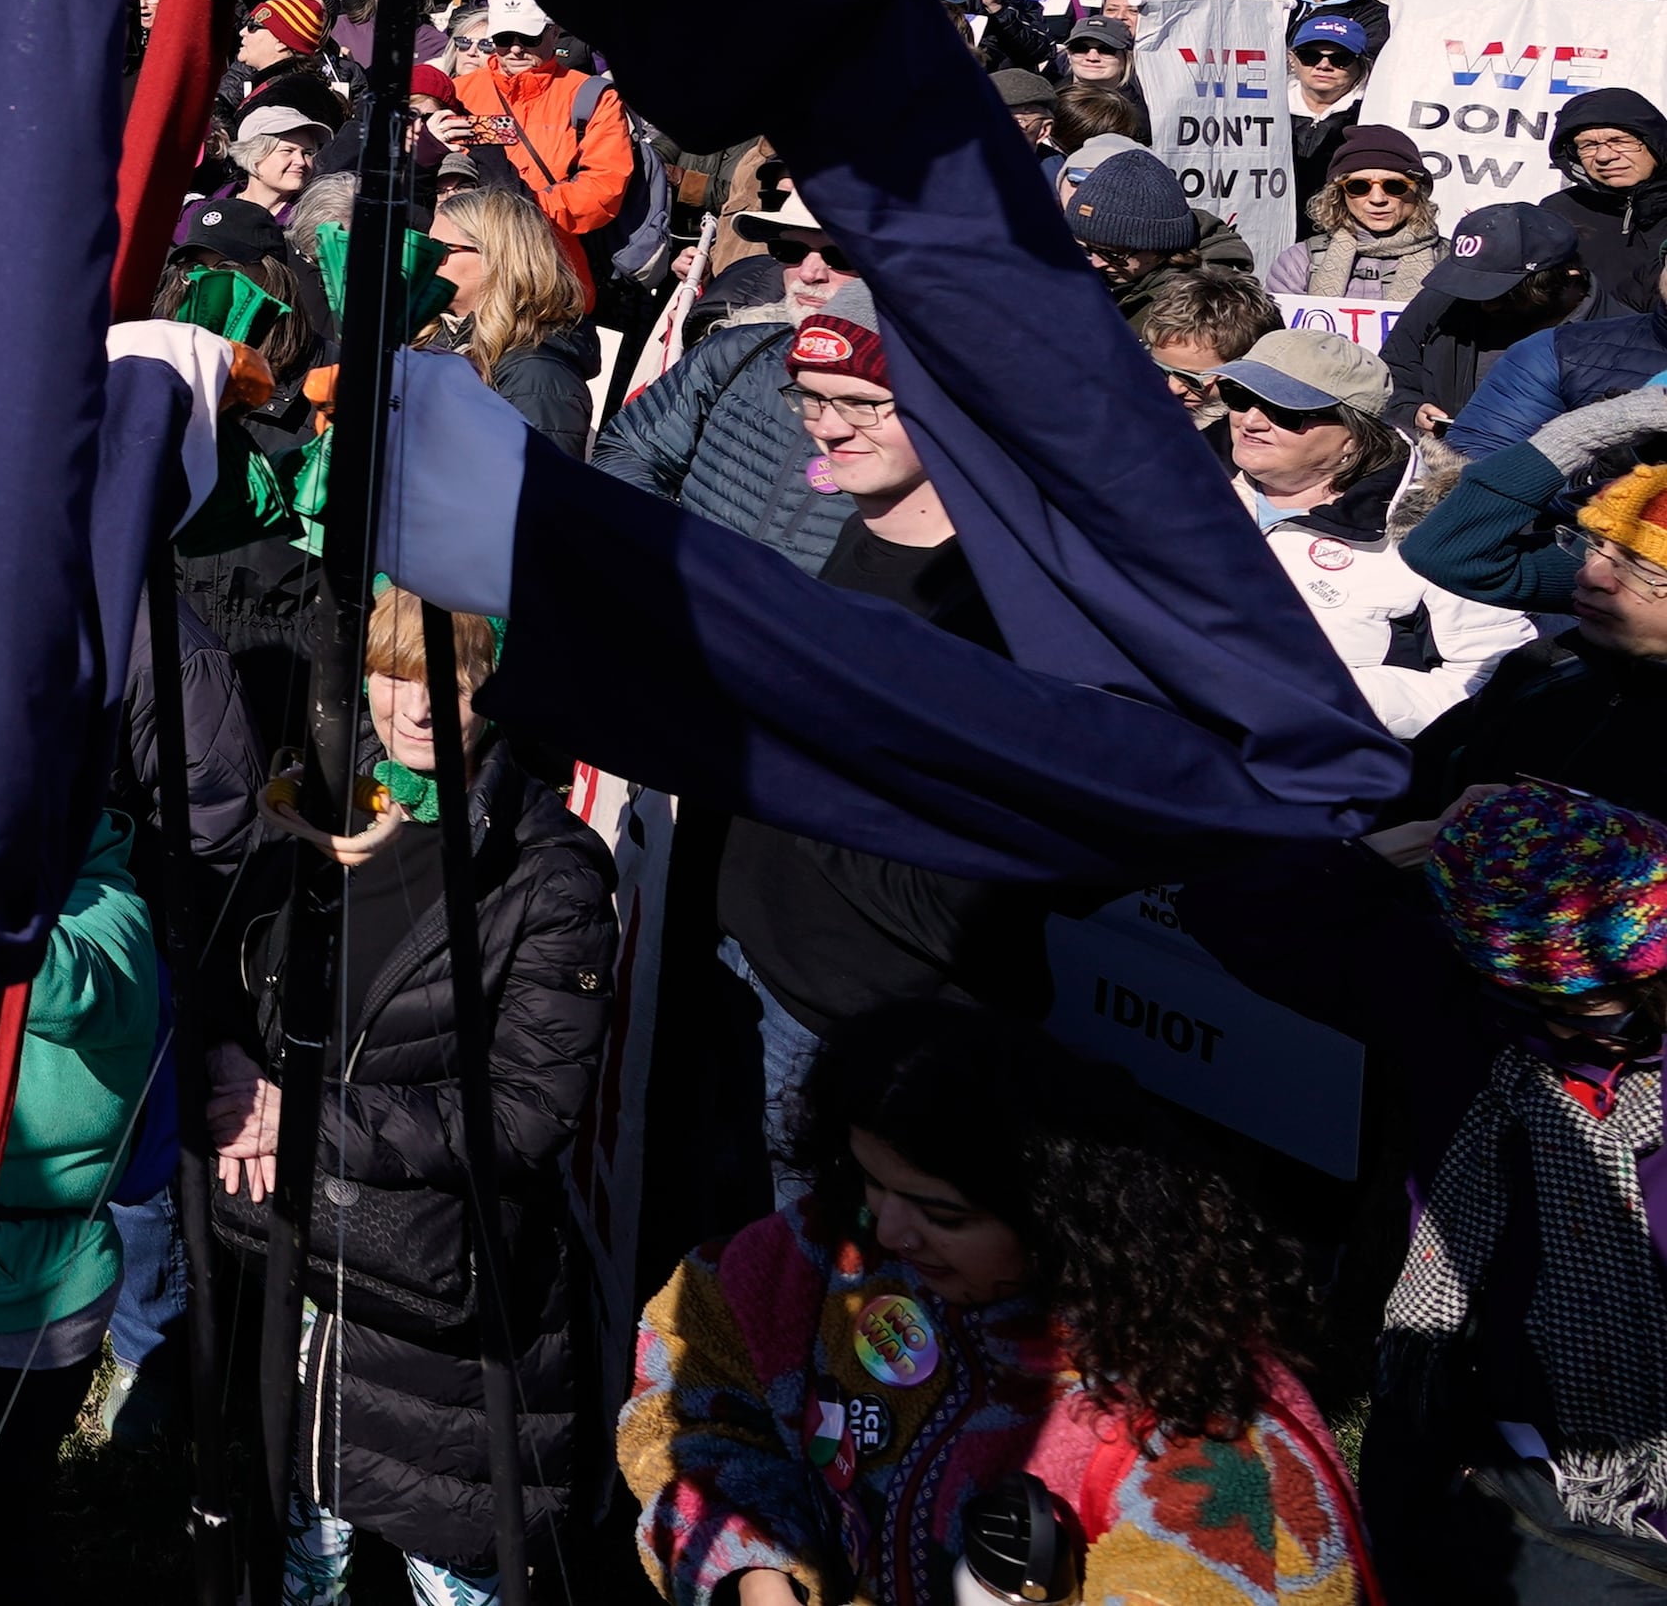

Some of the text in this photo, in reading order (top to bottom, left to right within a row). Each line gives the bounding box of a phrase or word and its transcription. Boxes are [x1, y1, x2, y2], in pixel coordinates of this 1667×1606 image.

[1178, 48, 1267, 98] WE
[1444, 39, 1609, 95] WE
[1177, 116, 1274, 147] DON'T
[1408, 100, 1562, 141] DON'
[1171, 169, 1287, 199] OW TO
[1420, 151, 1524, 188] OW
[812, 474, 838, 486] KING
[1140, 902, 1188, 928] NO
[1095, 978, 1223, 1064] IDIOT
[863, 1313, 916, 1379] WAR
[884, 1302, 928, 1352] NO
[866, 1405, 878, 1445] ICE
